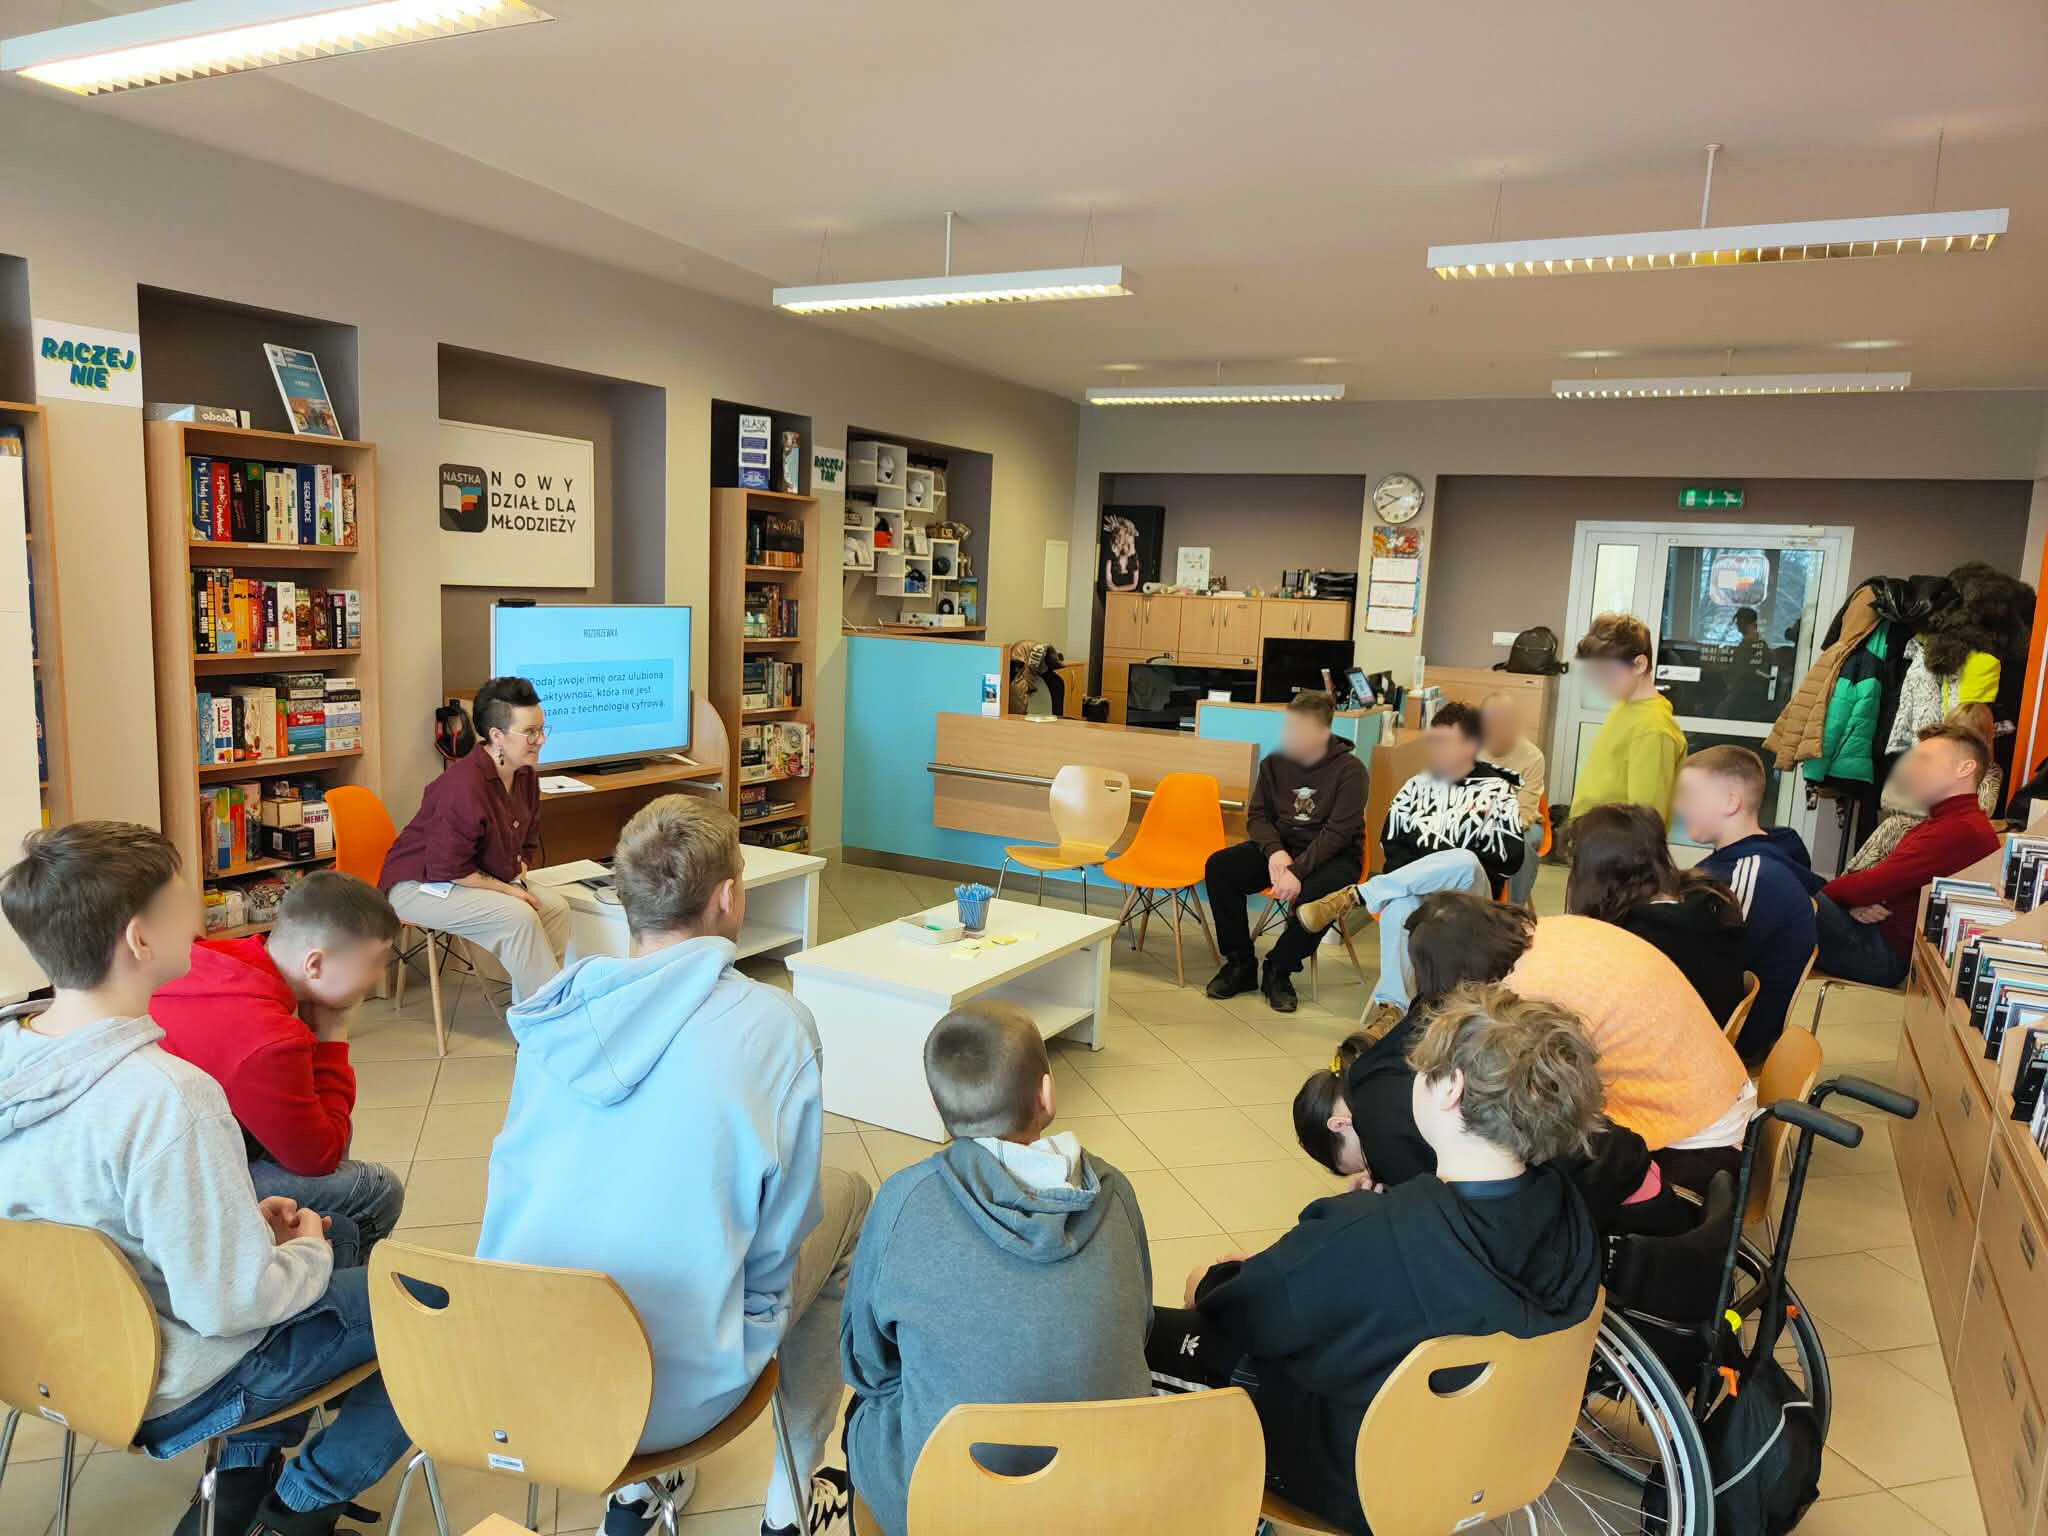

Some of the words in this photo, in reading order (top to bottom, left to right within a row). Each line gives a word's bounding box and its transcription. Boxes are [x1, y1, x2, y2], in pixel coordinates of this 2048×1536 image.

[41, 336, 136, 371] RACZEJ
[70, 363, 111, 390] NIE
[443, 471, 482, 485] NASTKA
[491, 471, 573, 493] NOWY
[303, 480, 312, 523] SEQUENCE
[491, 492, 540, 511] DZIAŁ
[545, 497, 576, 513] DLA
[491, 514, 576, 533] MŁODZIEŻY
[558, 675, 585, 687] swoje
[586, 673, 606, 685] imię
[608, 673, 626, 682] oraz
[622, 686, 635, 696] nie
[636, 685, 652, 697] jest
